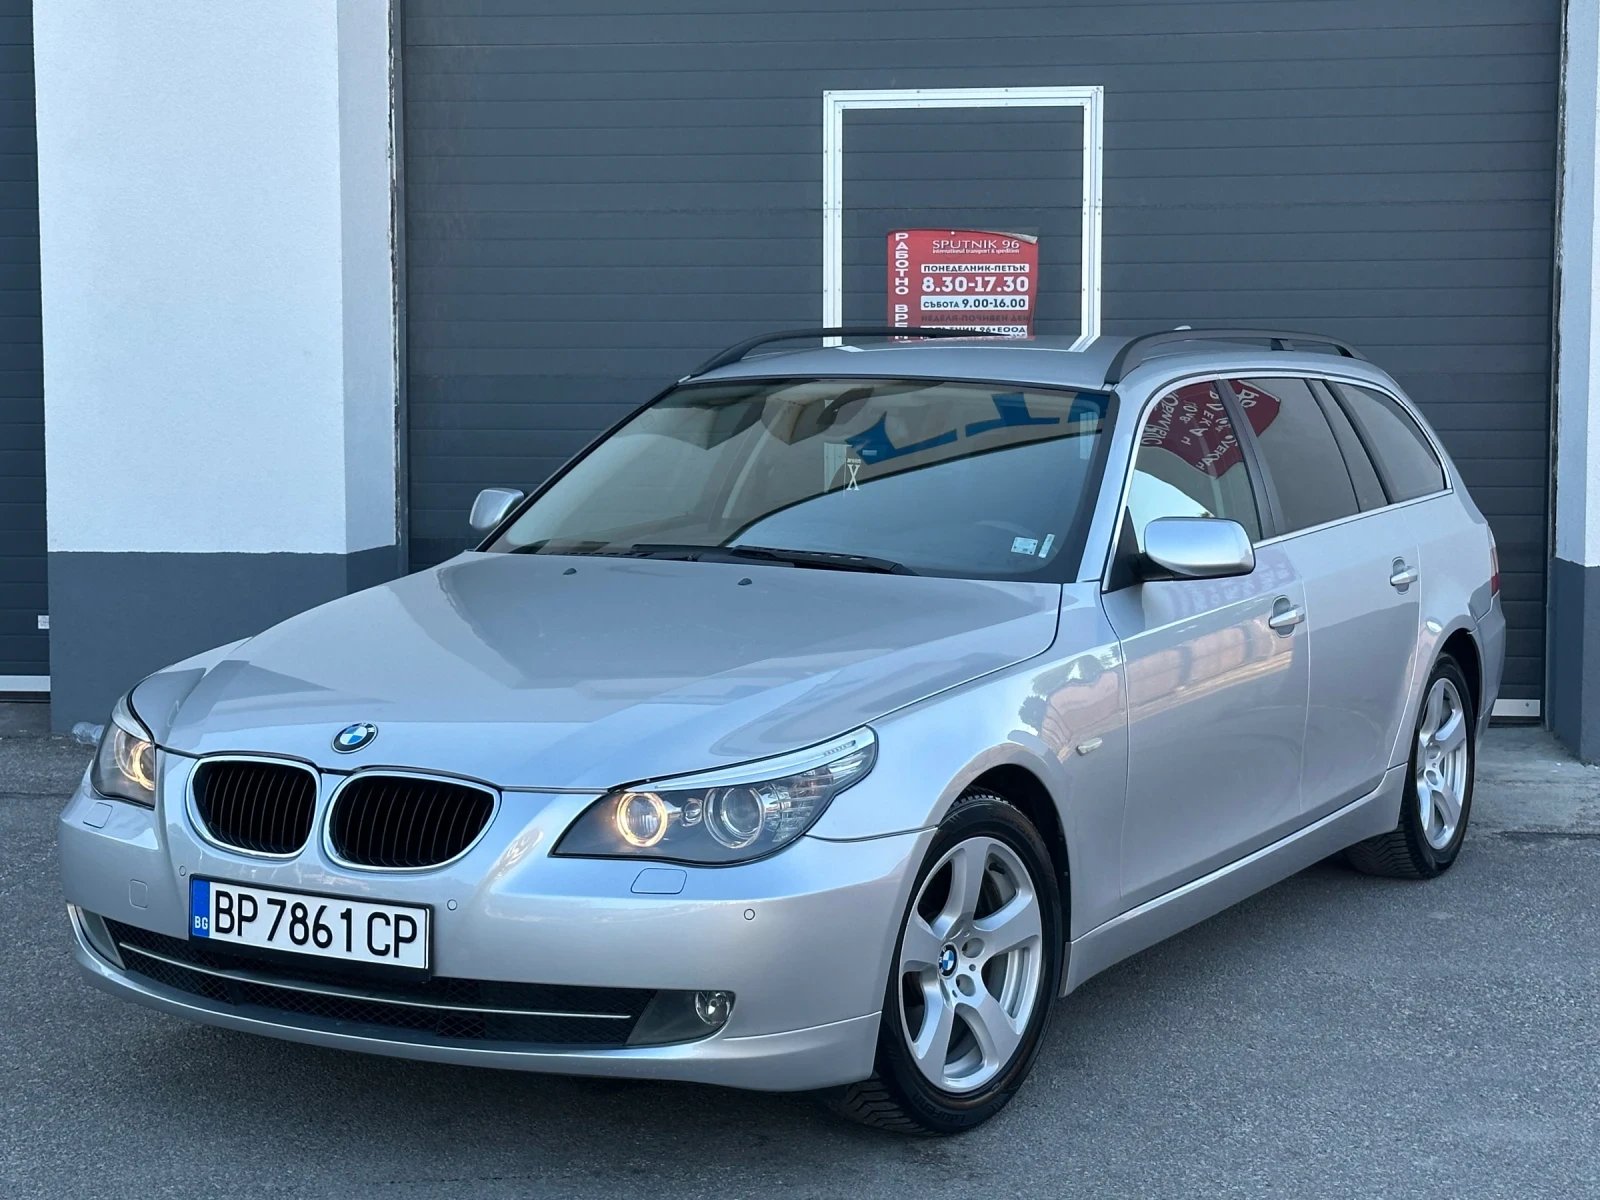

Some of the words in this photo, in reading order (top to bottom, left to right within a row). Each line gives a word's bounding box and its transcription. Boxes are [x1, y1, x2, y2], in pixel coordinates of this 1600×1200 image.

[932, 240, 997, 248] SPUTNIK
[1002, 240, 1020, 249] 96
[895, 232, 909, 295] РАБОТНО
[922, 276, 1029, 292] 8.30-17.30
[962, 298, 1026, 309] 9.00-16.00
[194, 915, 209, 930] BG
[214, 889, 259, 937] BP
[266, 897, 354, 953] 7861
[366, 911, 418, 958] CP
